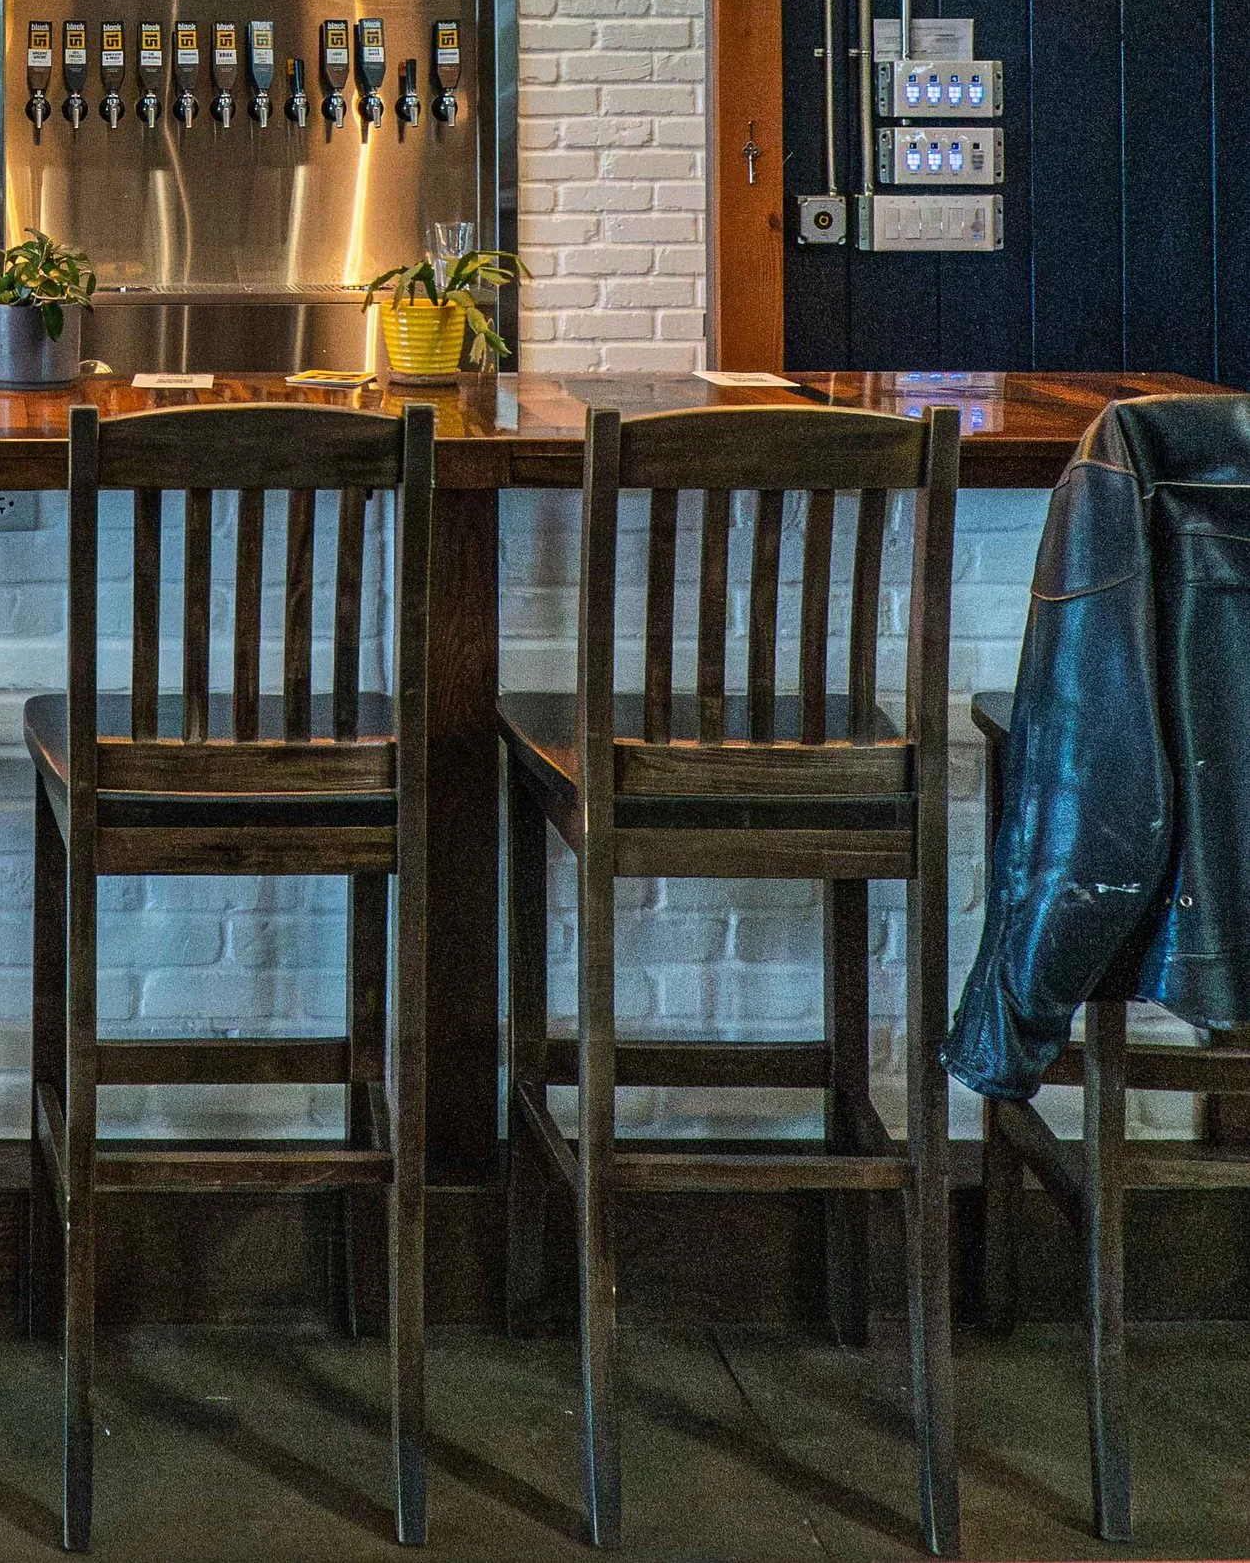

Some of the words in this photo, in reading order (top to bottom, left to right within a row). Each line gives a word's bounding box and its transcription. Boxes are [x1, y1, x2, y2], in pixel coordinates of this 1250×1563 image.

[31, 23, 50, 31] black
[67, 23, 85, 31] black
[103, 23, 122, 31] black
[177, 23, 196, 31] black
[216, 23, 235, 31] black
[327, 22, 346, 30] black
[363, 20, 381, 28] black
[438, 22, 457, 30] black
